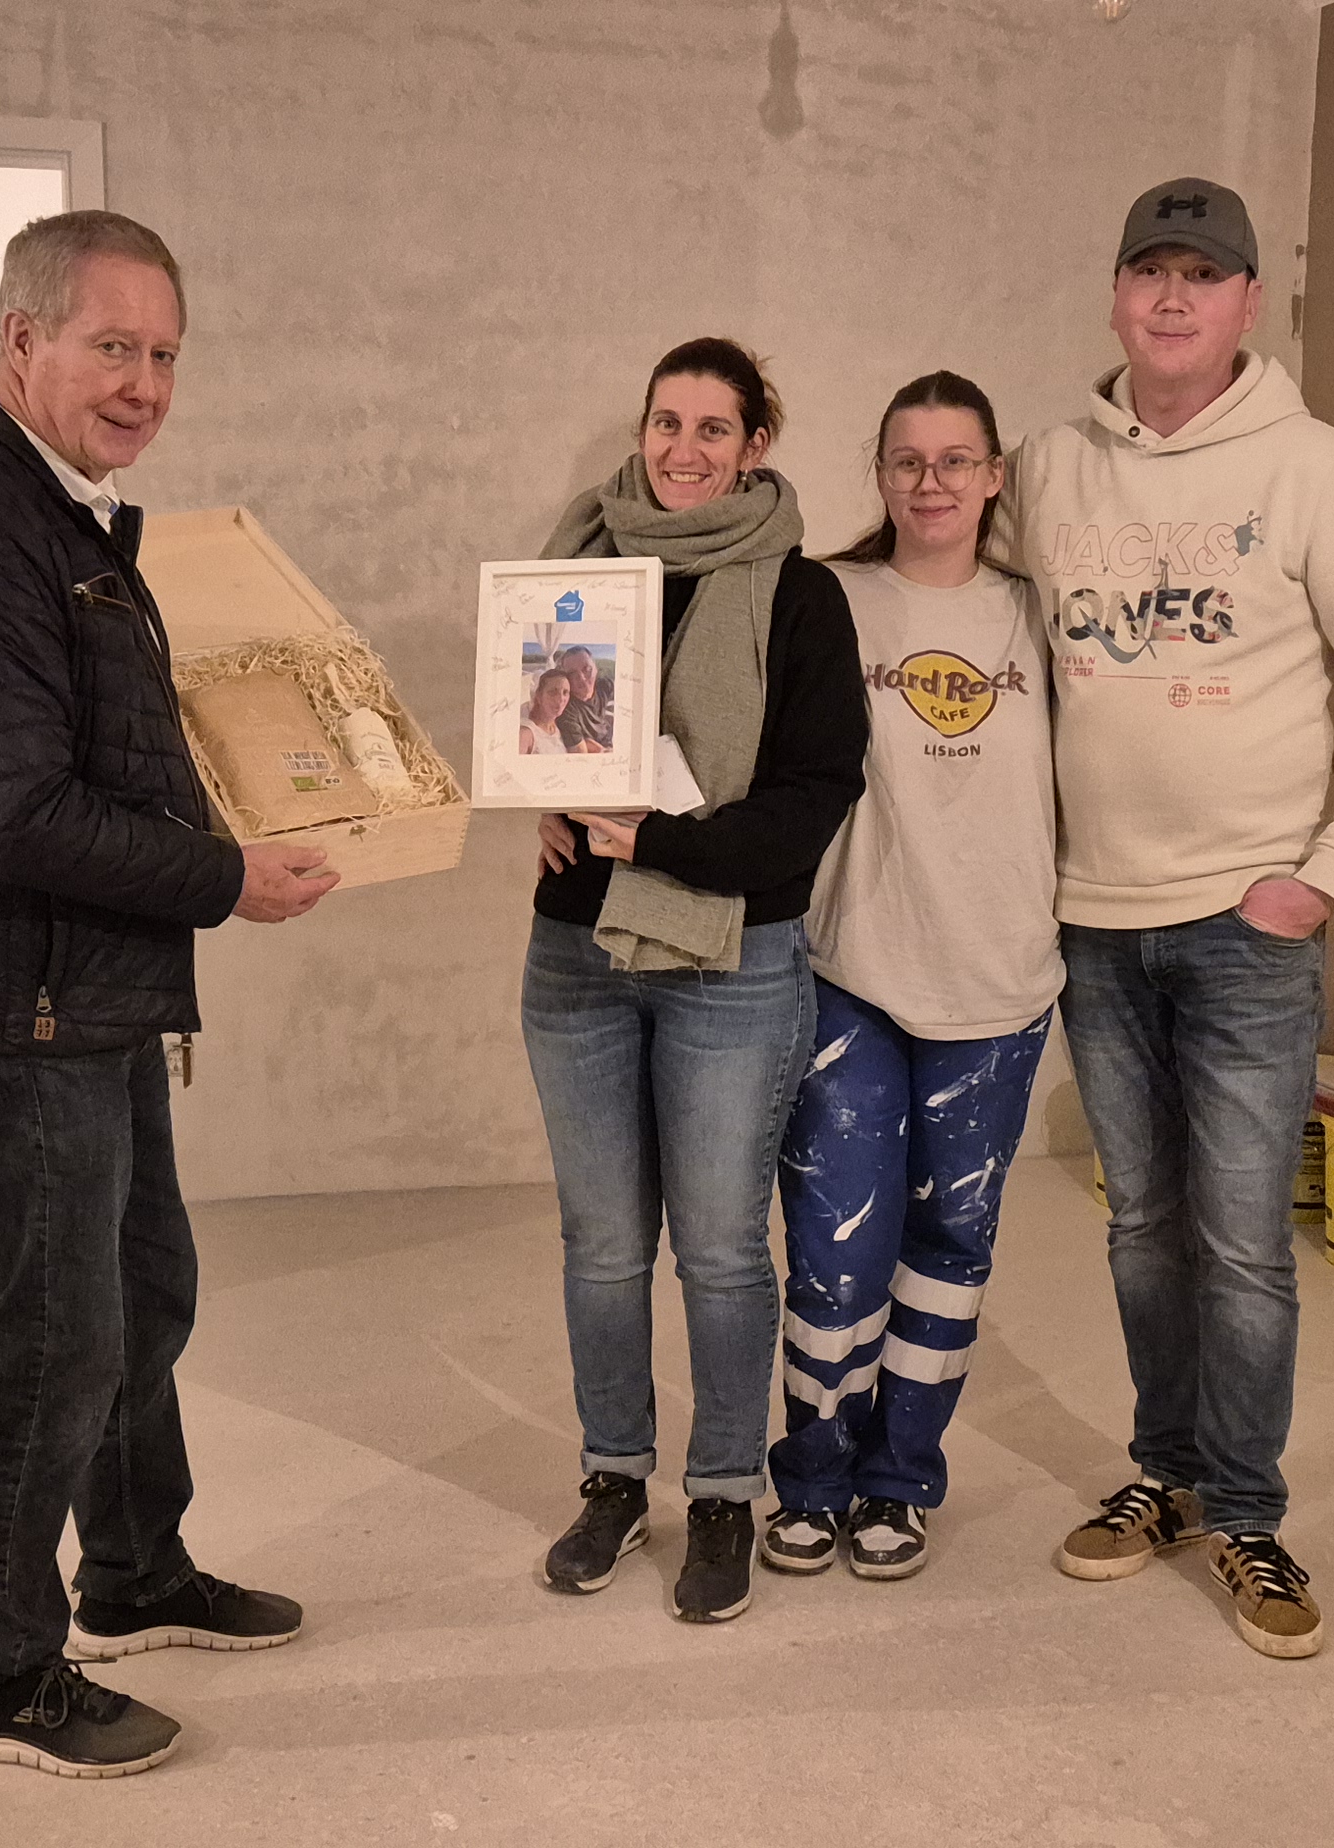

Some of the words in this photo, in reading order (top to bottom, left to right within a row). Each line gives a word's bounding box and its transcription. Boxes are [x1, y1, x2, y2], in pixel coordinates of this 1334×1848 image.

[865, 663, 942, 698] Hard
[945, 661, 1029, 703] Rock
[1198, 686, 1230, 696] CORE
[930, 706, 970, 722] CAFE
[924, 743, 981, 757] LISBON
